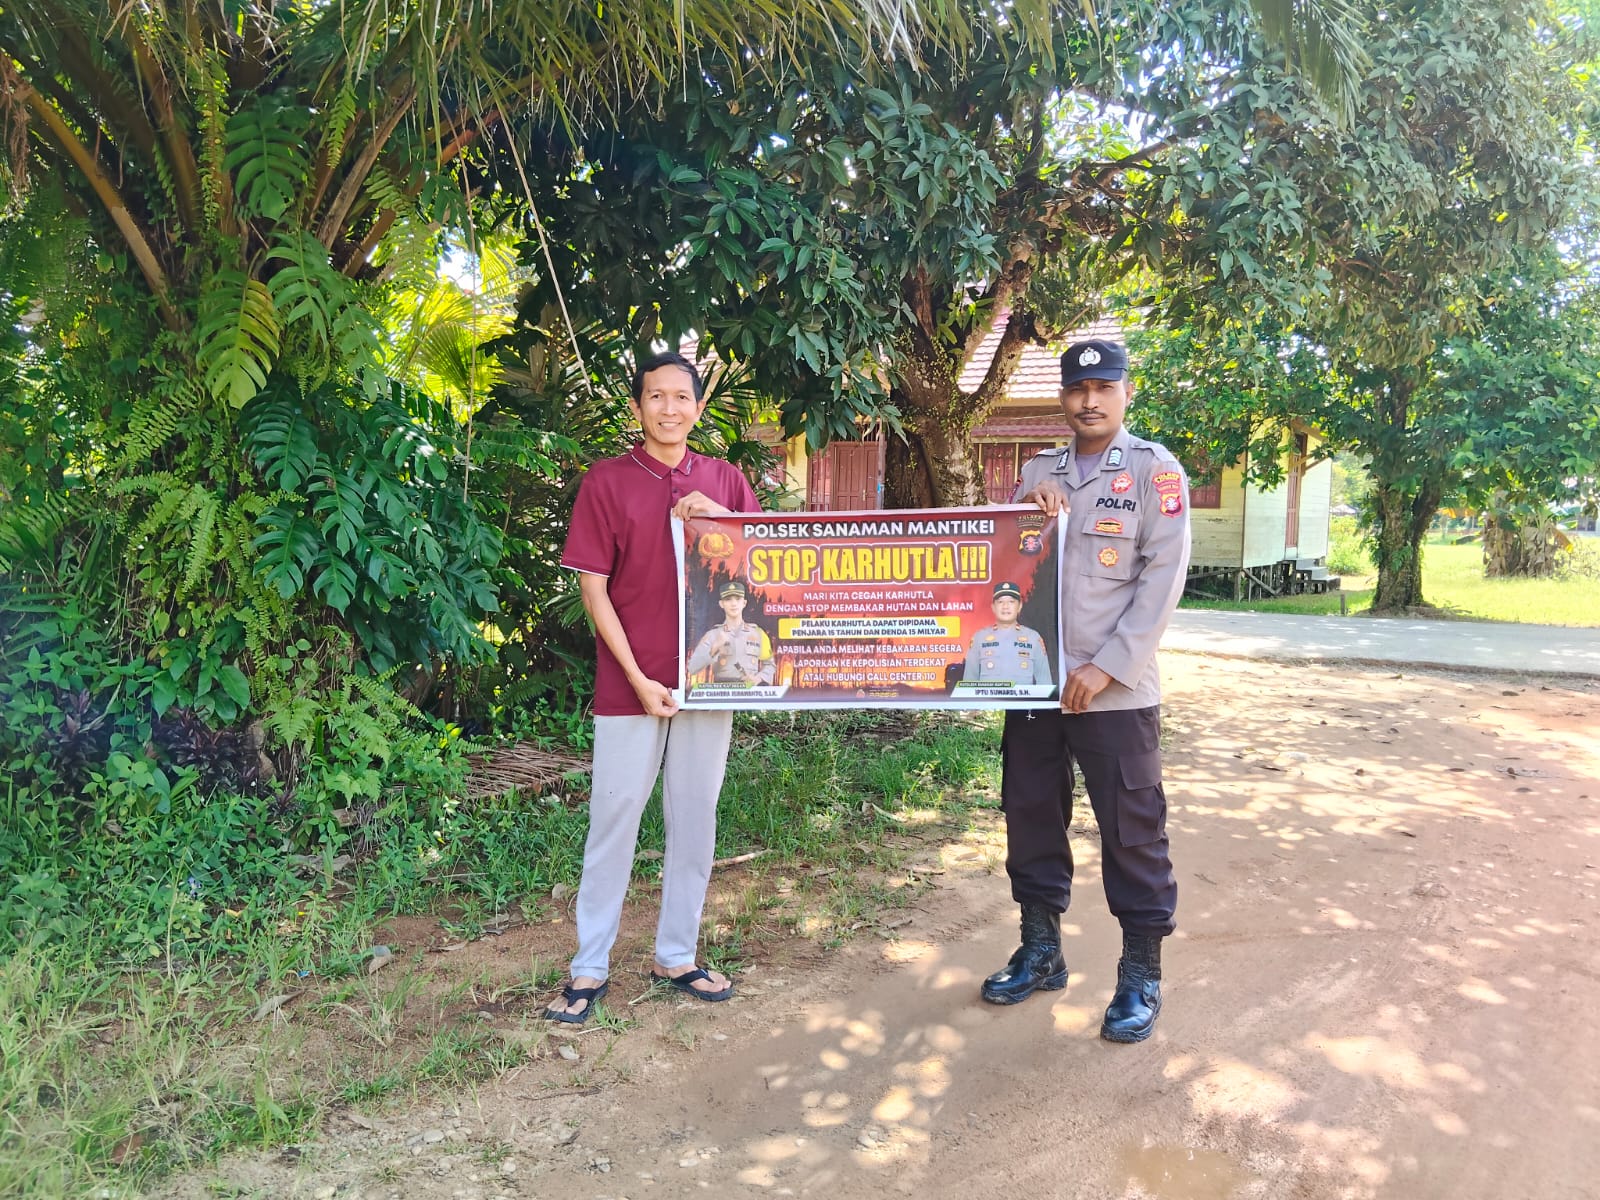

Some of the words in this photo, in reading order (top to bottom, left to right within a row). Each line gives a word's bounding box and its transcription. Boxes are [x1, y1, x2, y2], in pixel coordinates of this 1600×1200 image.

[1096, 497, 1136, 512] POLRI
[744, 523, 809, 538] POLSEK
[813, 522, 903, 537] SANAMAN
[908, 519, 995, 535] MANTIKEI
[751, 549, 817, 582] STOP
[823, 547, 955, 581] KARHUTLA
[960, 546, 987, 579] !!!
[804, 592, 828, 601] MARI
[830, 592, 849, 601] KITA
[851, 591, 884, 600] CEGAH
[886, 590, 934, 600] KARHUTLA
[765, 604, 803, 613] DENGAN
[806, 604, 829, 612] STOP
[831, 603, 884, 612] MEMBAKAR
[886, 602, 917, 611] HUTAN
[919, 602, 937, 611] DAN
[940, 601, 973, 611] LAHAN
[792, 629, 825, 637] PENJARA
[777, 646, 812, 654] APABILA
[813, 646, 838, 654] ANDA
[839, 645, 874, 653] MELIHAT
[876, 644, 929, 653] KEBAKARAN
[929, 644, 962, 653] SEGERA
[1013, 641, 1033, 649] POLRI
[793, 659, 838, 668] LAPORKAN
[840, 659, 851, 667] KE
[852, 658, 902, 667] KEPOLISIAN
[903, 658, 946, 667] TERDEKAT
[826, 673, 866, 682] HUBUNGI
[867, 672, 888, 681] CALL
[889, 672, 922, 681] CENTER
